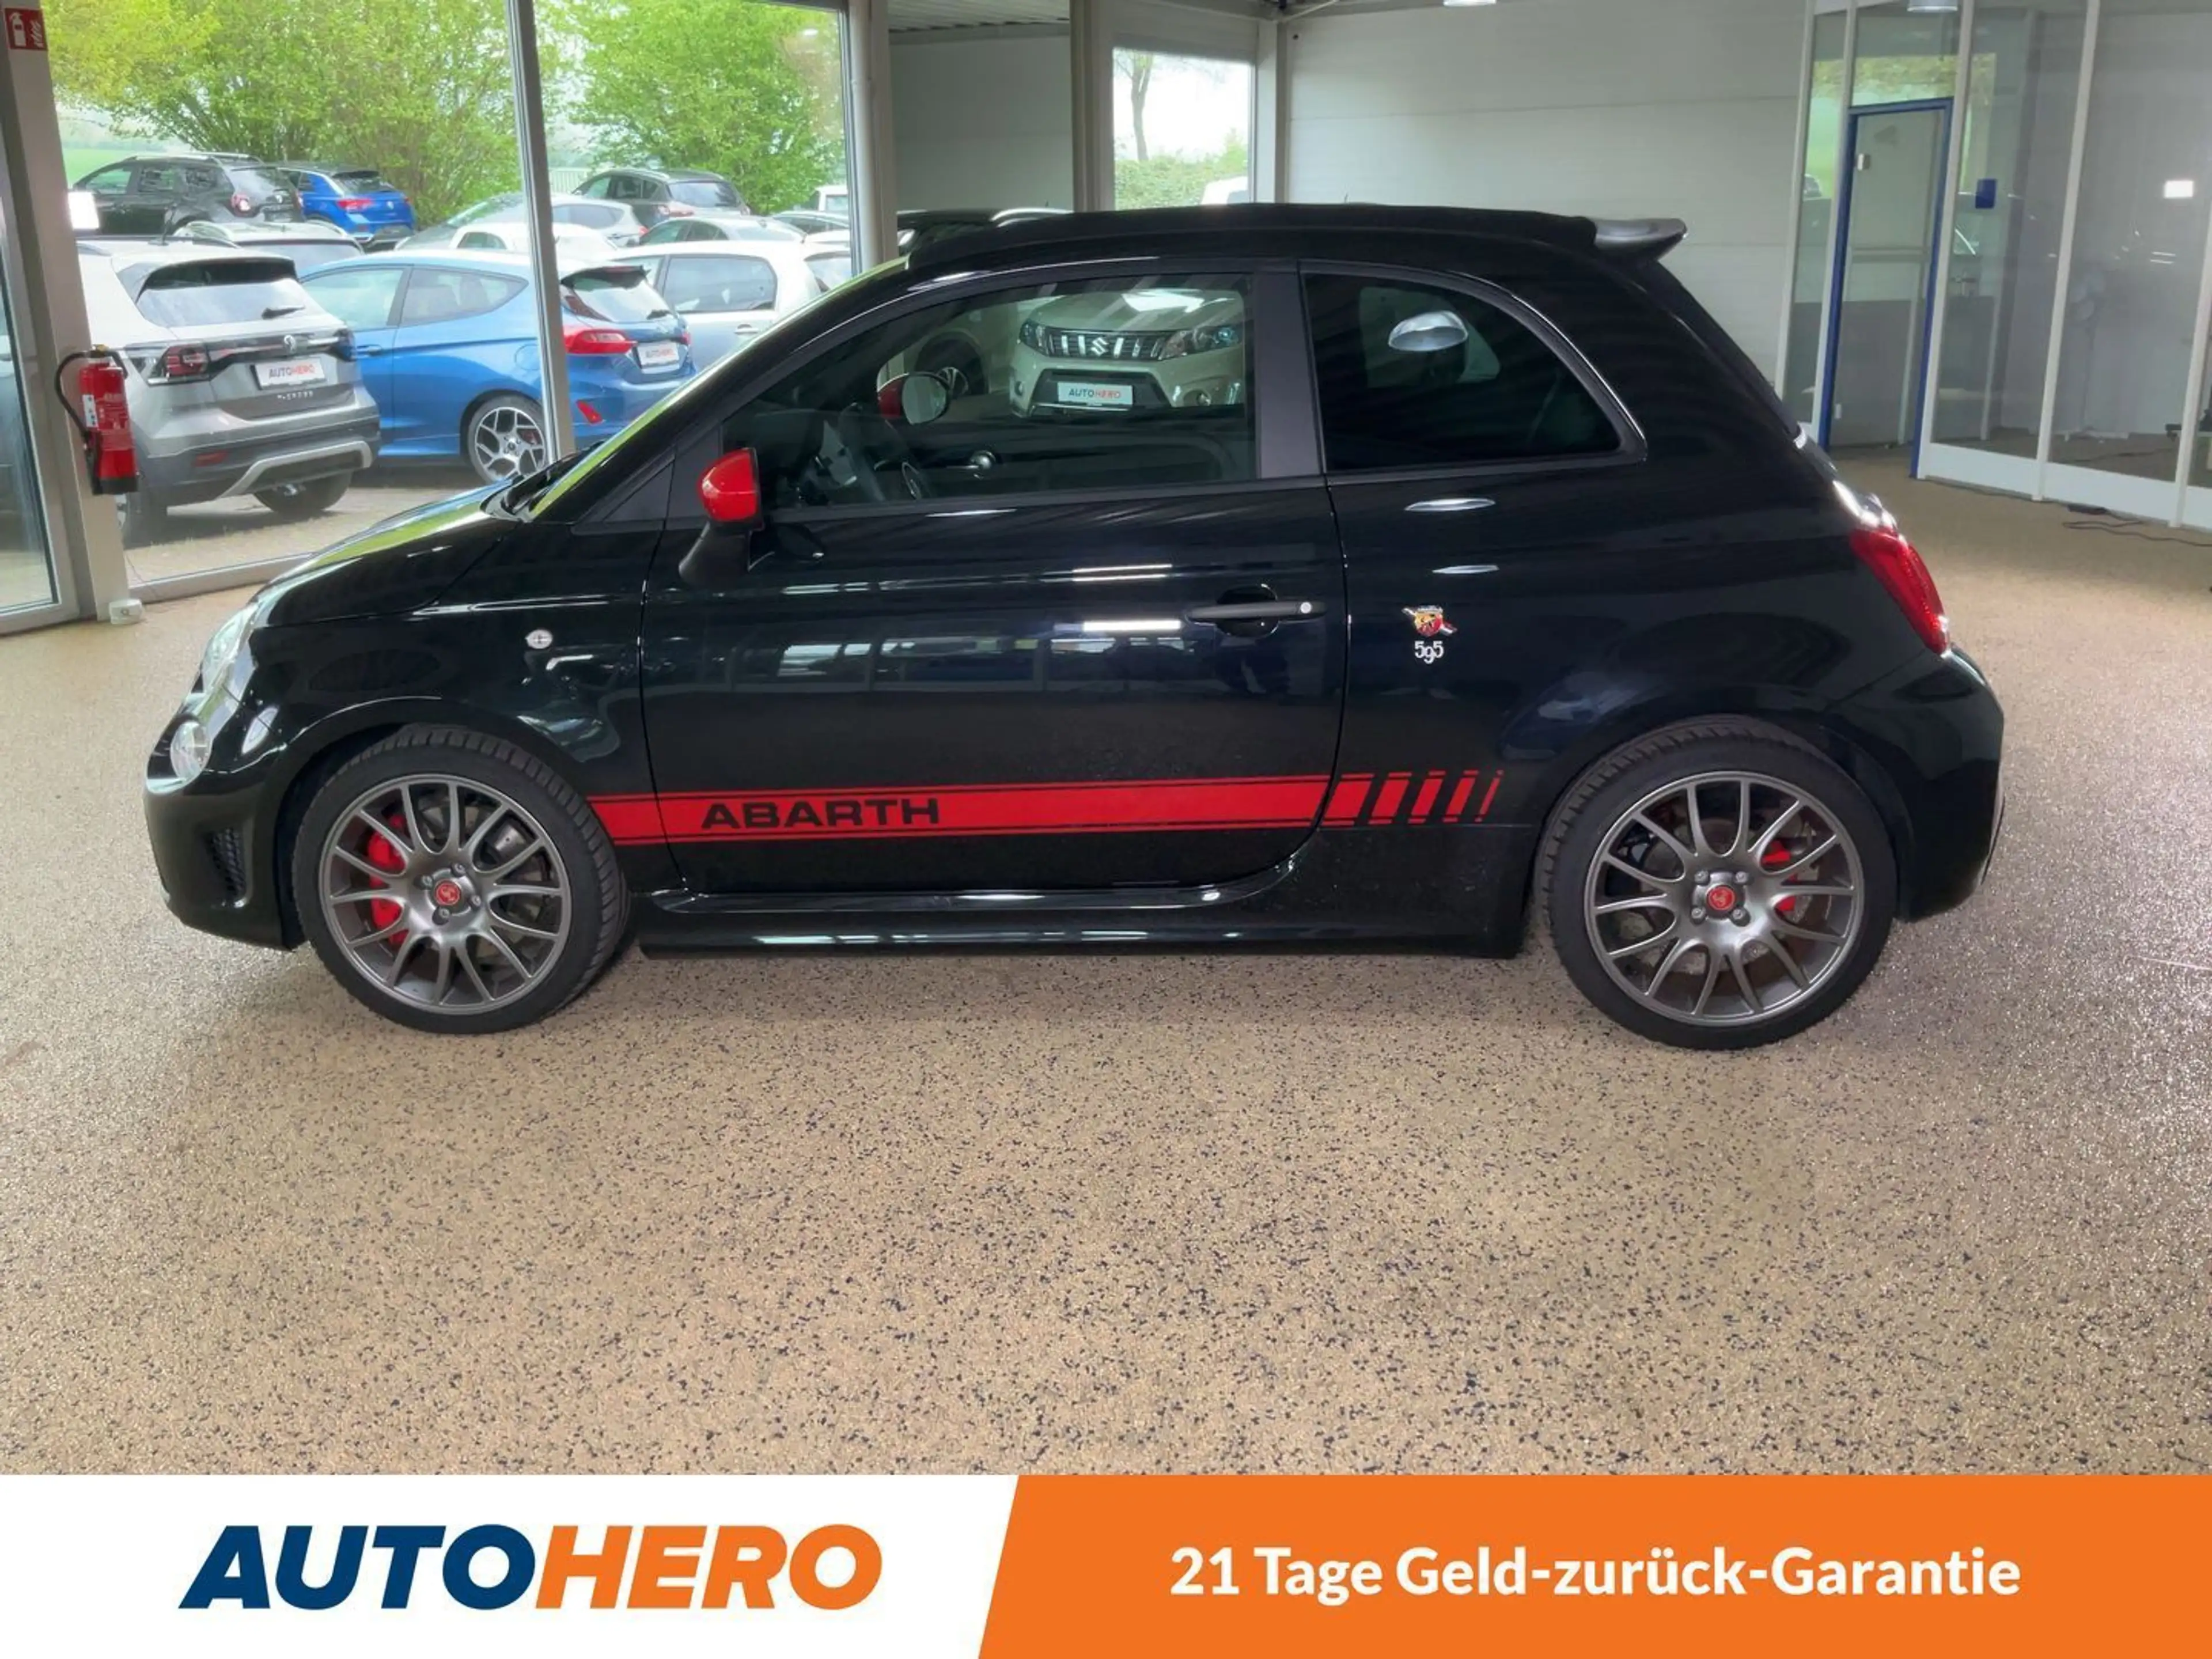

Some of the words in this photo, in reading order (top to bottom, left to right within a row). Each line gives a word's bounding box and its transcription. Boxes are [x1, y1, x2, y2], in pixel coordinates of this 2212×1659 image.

[1069, 388, 1121, 399] AUTOHERO
[1414, 641, 1444, 664] 595
[700, 798, 940, 829] ABARTH
